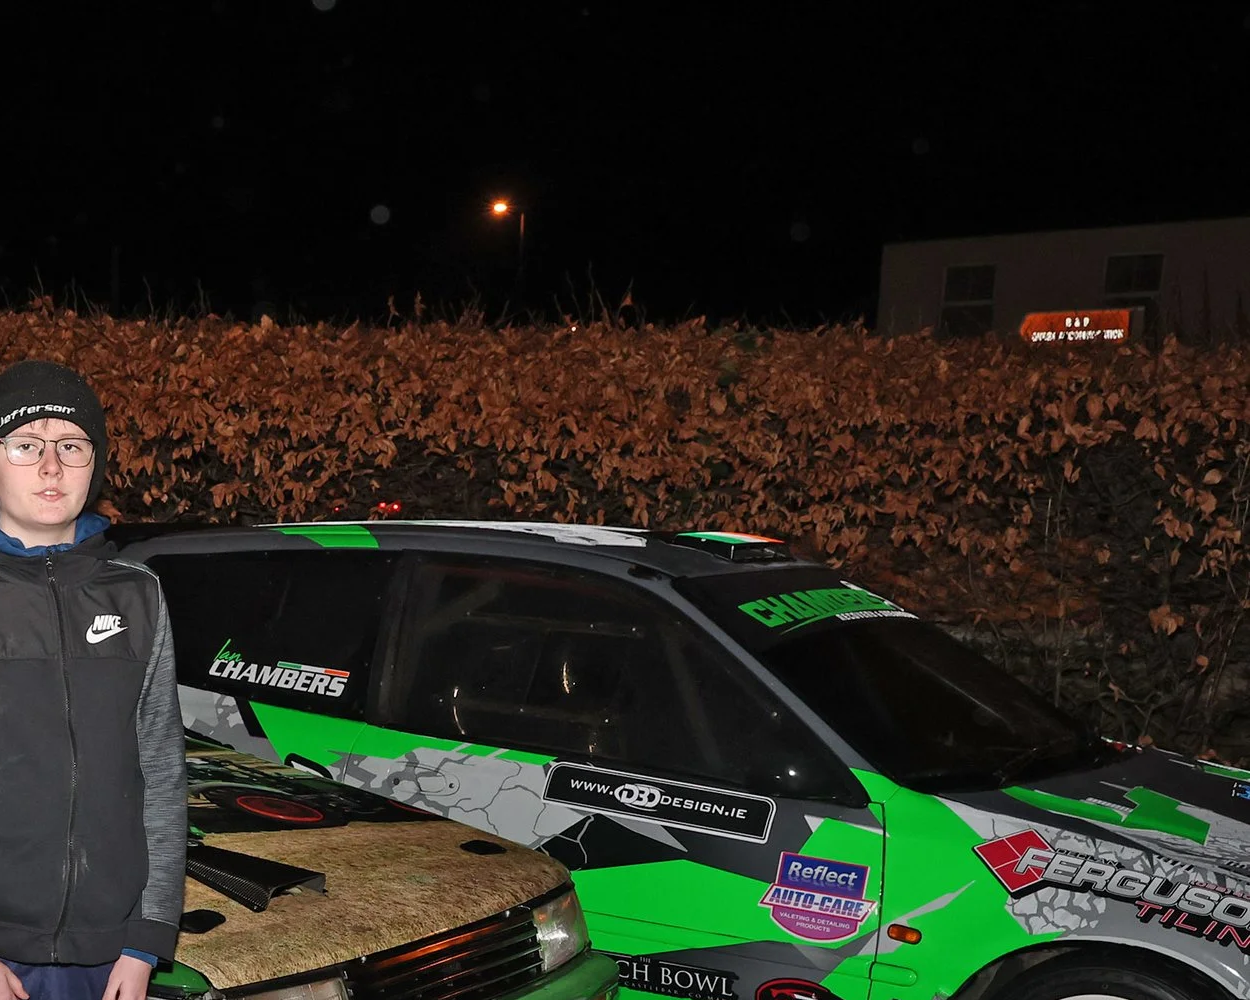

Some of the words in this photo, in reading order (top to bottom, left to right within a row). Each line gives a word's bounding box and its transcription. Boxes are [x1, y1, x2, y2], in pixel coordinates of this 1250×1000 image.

[93, 614, 121, 631] NIKE
[214, 638, 243, 663] Ian
[209, 659, 348, 697] CHAMBERS
[788, 861, 857, 886] Reflect
[1015, 847, 1250, 928] FERGUSO
[769, 887, 864, 918] AUTO-CARE
[779, 911, 810, 922] VALETING
[816, 918, 850, 930] DETAILING
[795, 922, 831, 933] PRODUCTS
[661, 967, 733, 996] BOWL
